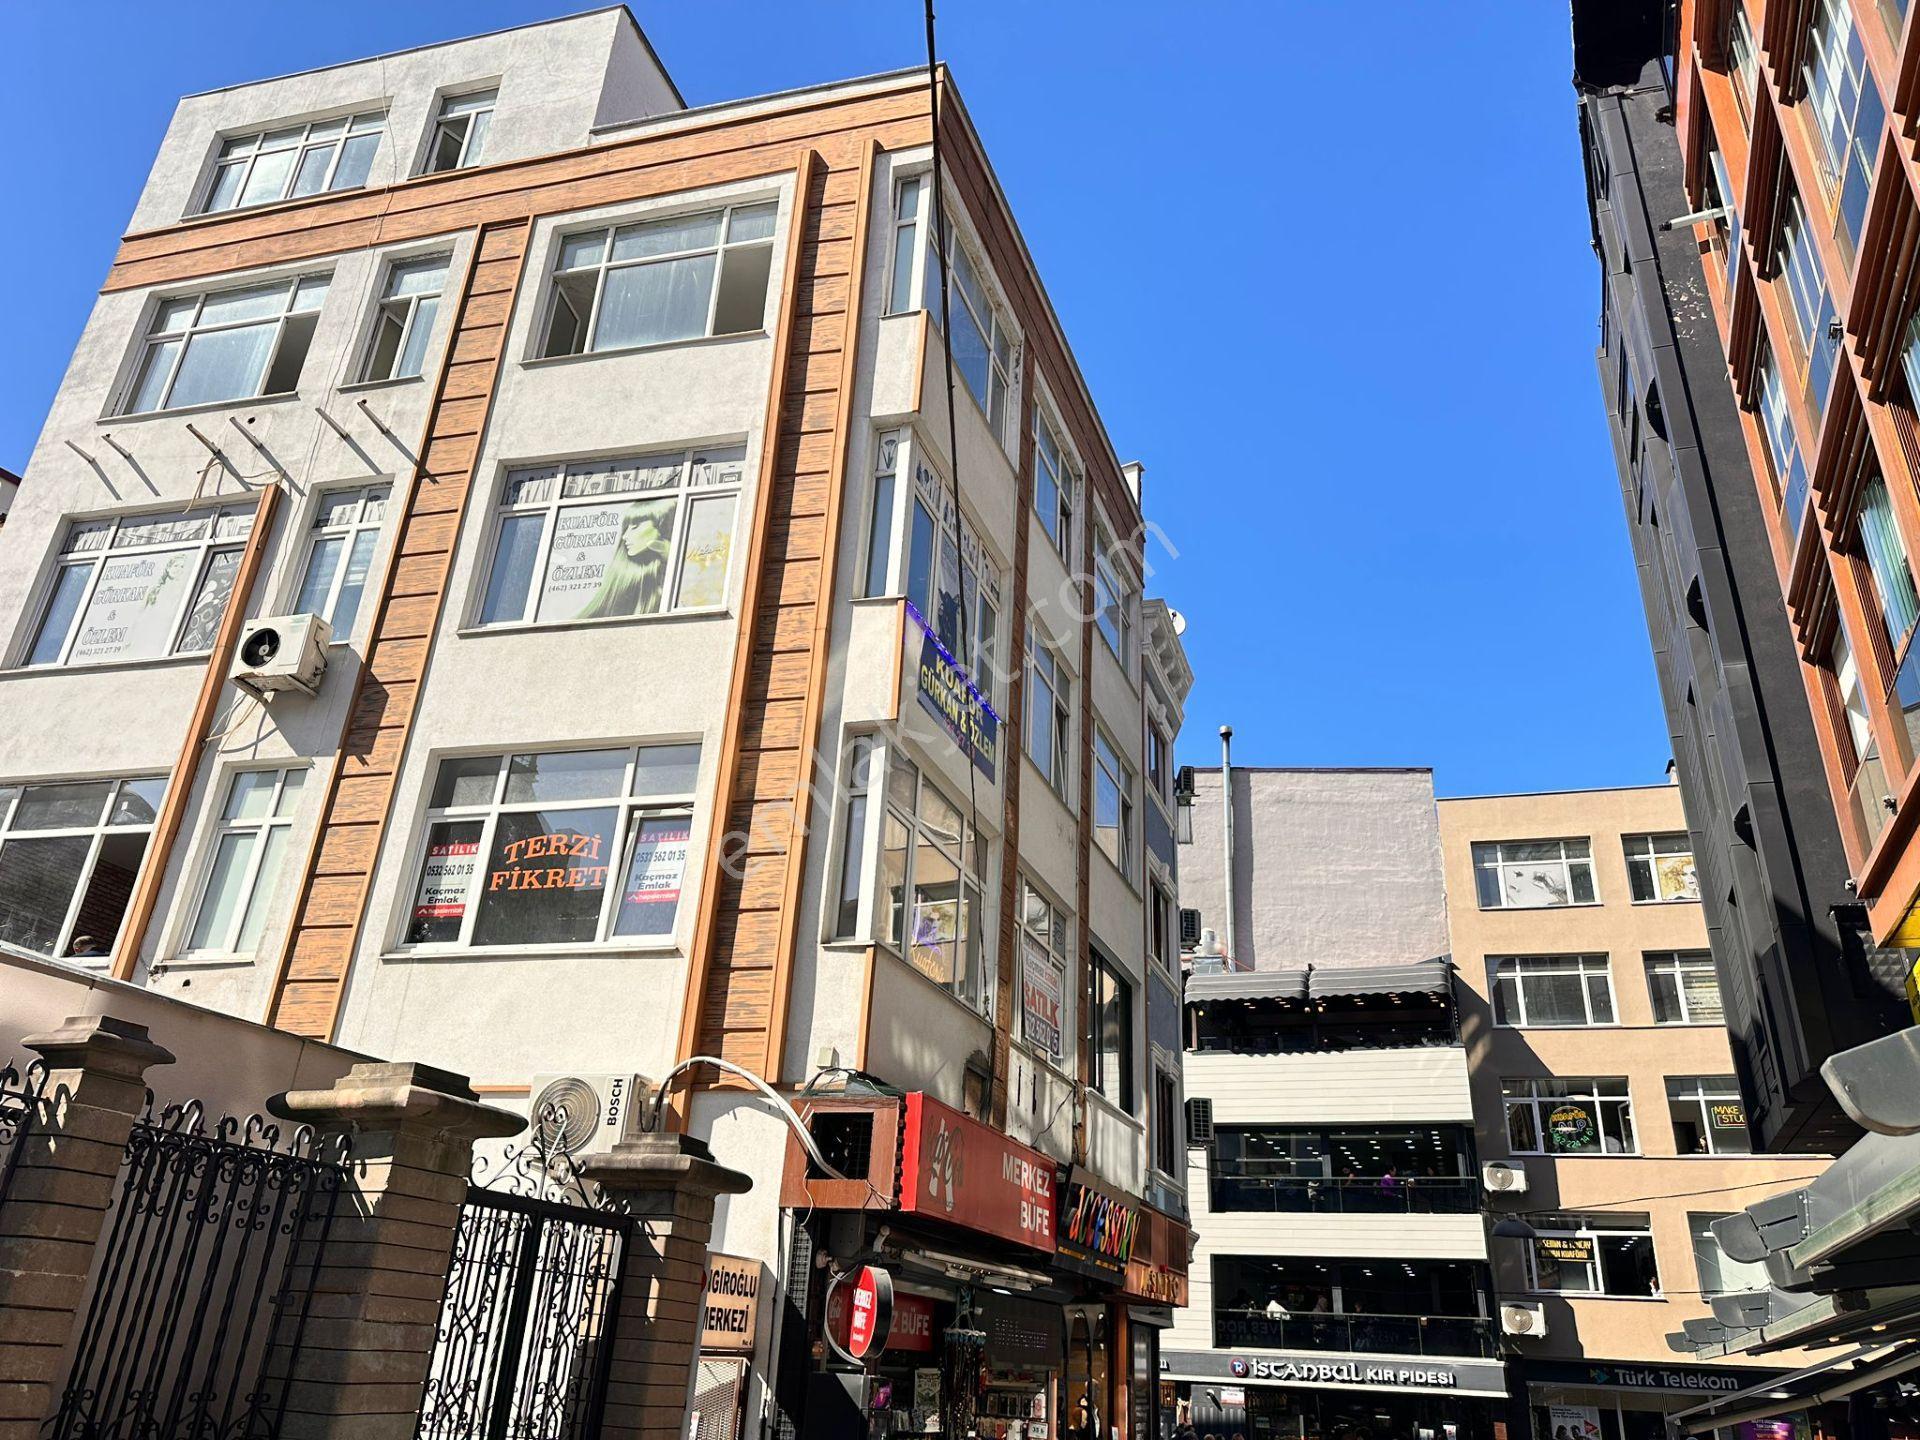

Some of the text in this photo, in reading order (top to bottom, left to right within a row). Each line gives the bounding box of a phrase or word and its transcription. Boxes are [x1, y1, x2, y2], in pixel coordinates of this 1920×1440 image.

[558, 511, 618, 531] KUAFÖR
[553, 532, 618, 550] GÜRKAN
[576, 552, 586, 561] &
[552, 563, 605, 582] ÖZLEM
[921, 665, 958, 725] GÜRKAN
[504, 832, 602, 865] TERZİ
[653, 851, 666, 862] 562
[677, 849, 686, 860] 35
[427, 865, 443, 876] 0532
[443, 864, 455, 876] 562
[465, 863, 474, 874] 35
[489, 866, 608, 891] FİKRET
[635, 873, 678, 882] Kaçmaz
[425, 887, 466, 895] Kaçmaz
[638, 881, 671, 889] Emlak
[427, 896, 459, 904] Emlak
[607, 1078, 623, 1126] BOSCH
[1714, 1105, 1739, 1115] MAKE
[1002, 1152, 1050, 1197] MERKEZ
[1020, 1197, 1049, 1236] BÜFE
[901, 1307, 929, 1336] BÜFE
[1251, 1358, 1363, 1381] İSTANBUL
[1366, 1368, 1395, 1382] KIR
[1613, 1368, 1738, 1391] Türk Telekom
